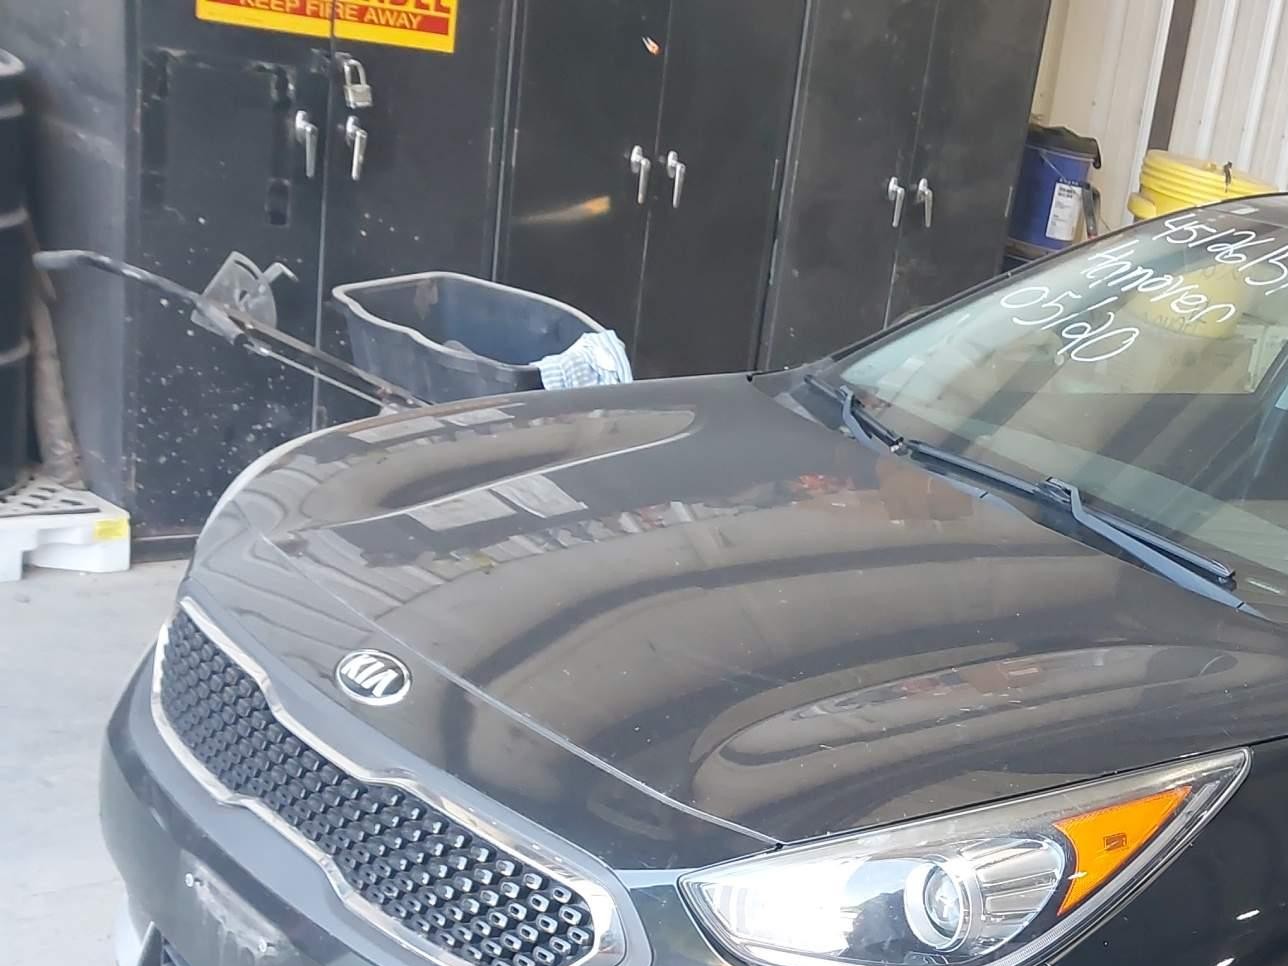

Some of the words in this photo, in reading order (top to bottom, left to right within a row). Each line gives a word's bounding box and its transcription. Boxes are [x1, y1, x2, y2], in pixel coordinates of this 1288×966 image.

[305, 0, 358, 21] FIRE
[363, 6, 422, 30] AWAY
[1080, 239, 1236, 322] Hanover
[340, 653, 399, 698] KIA
